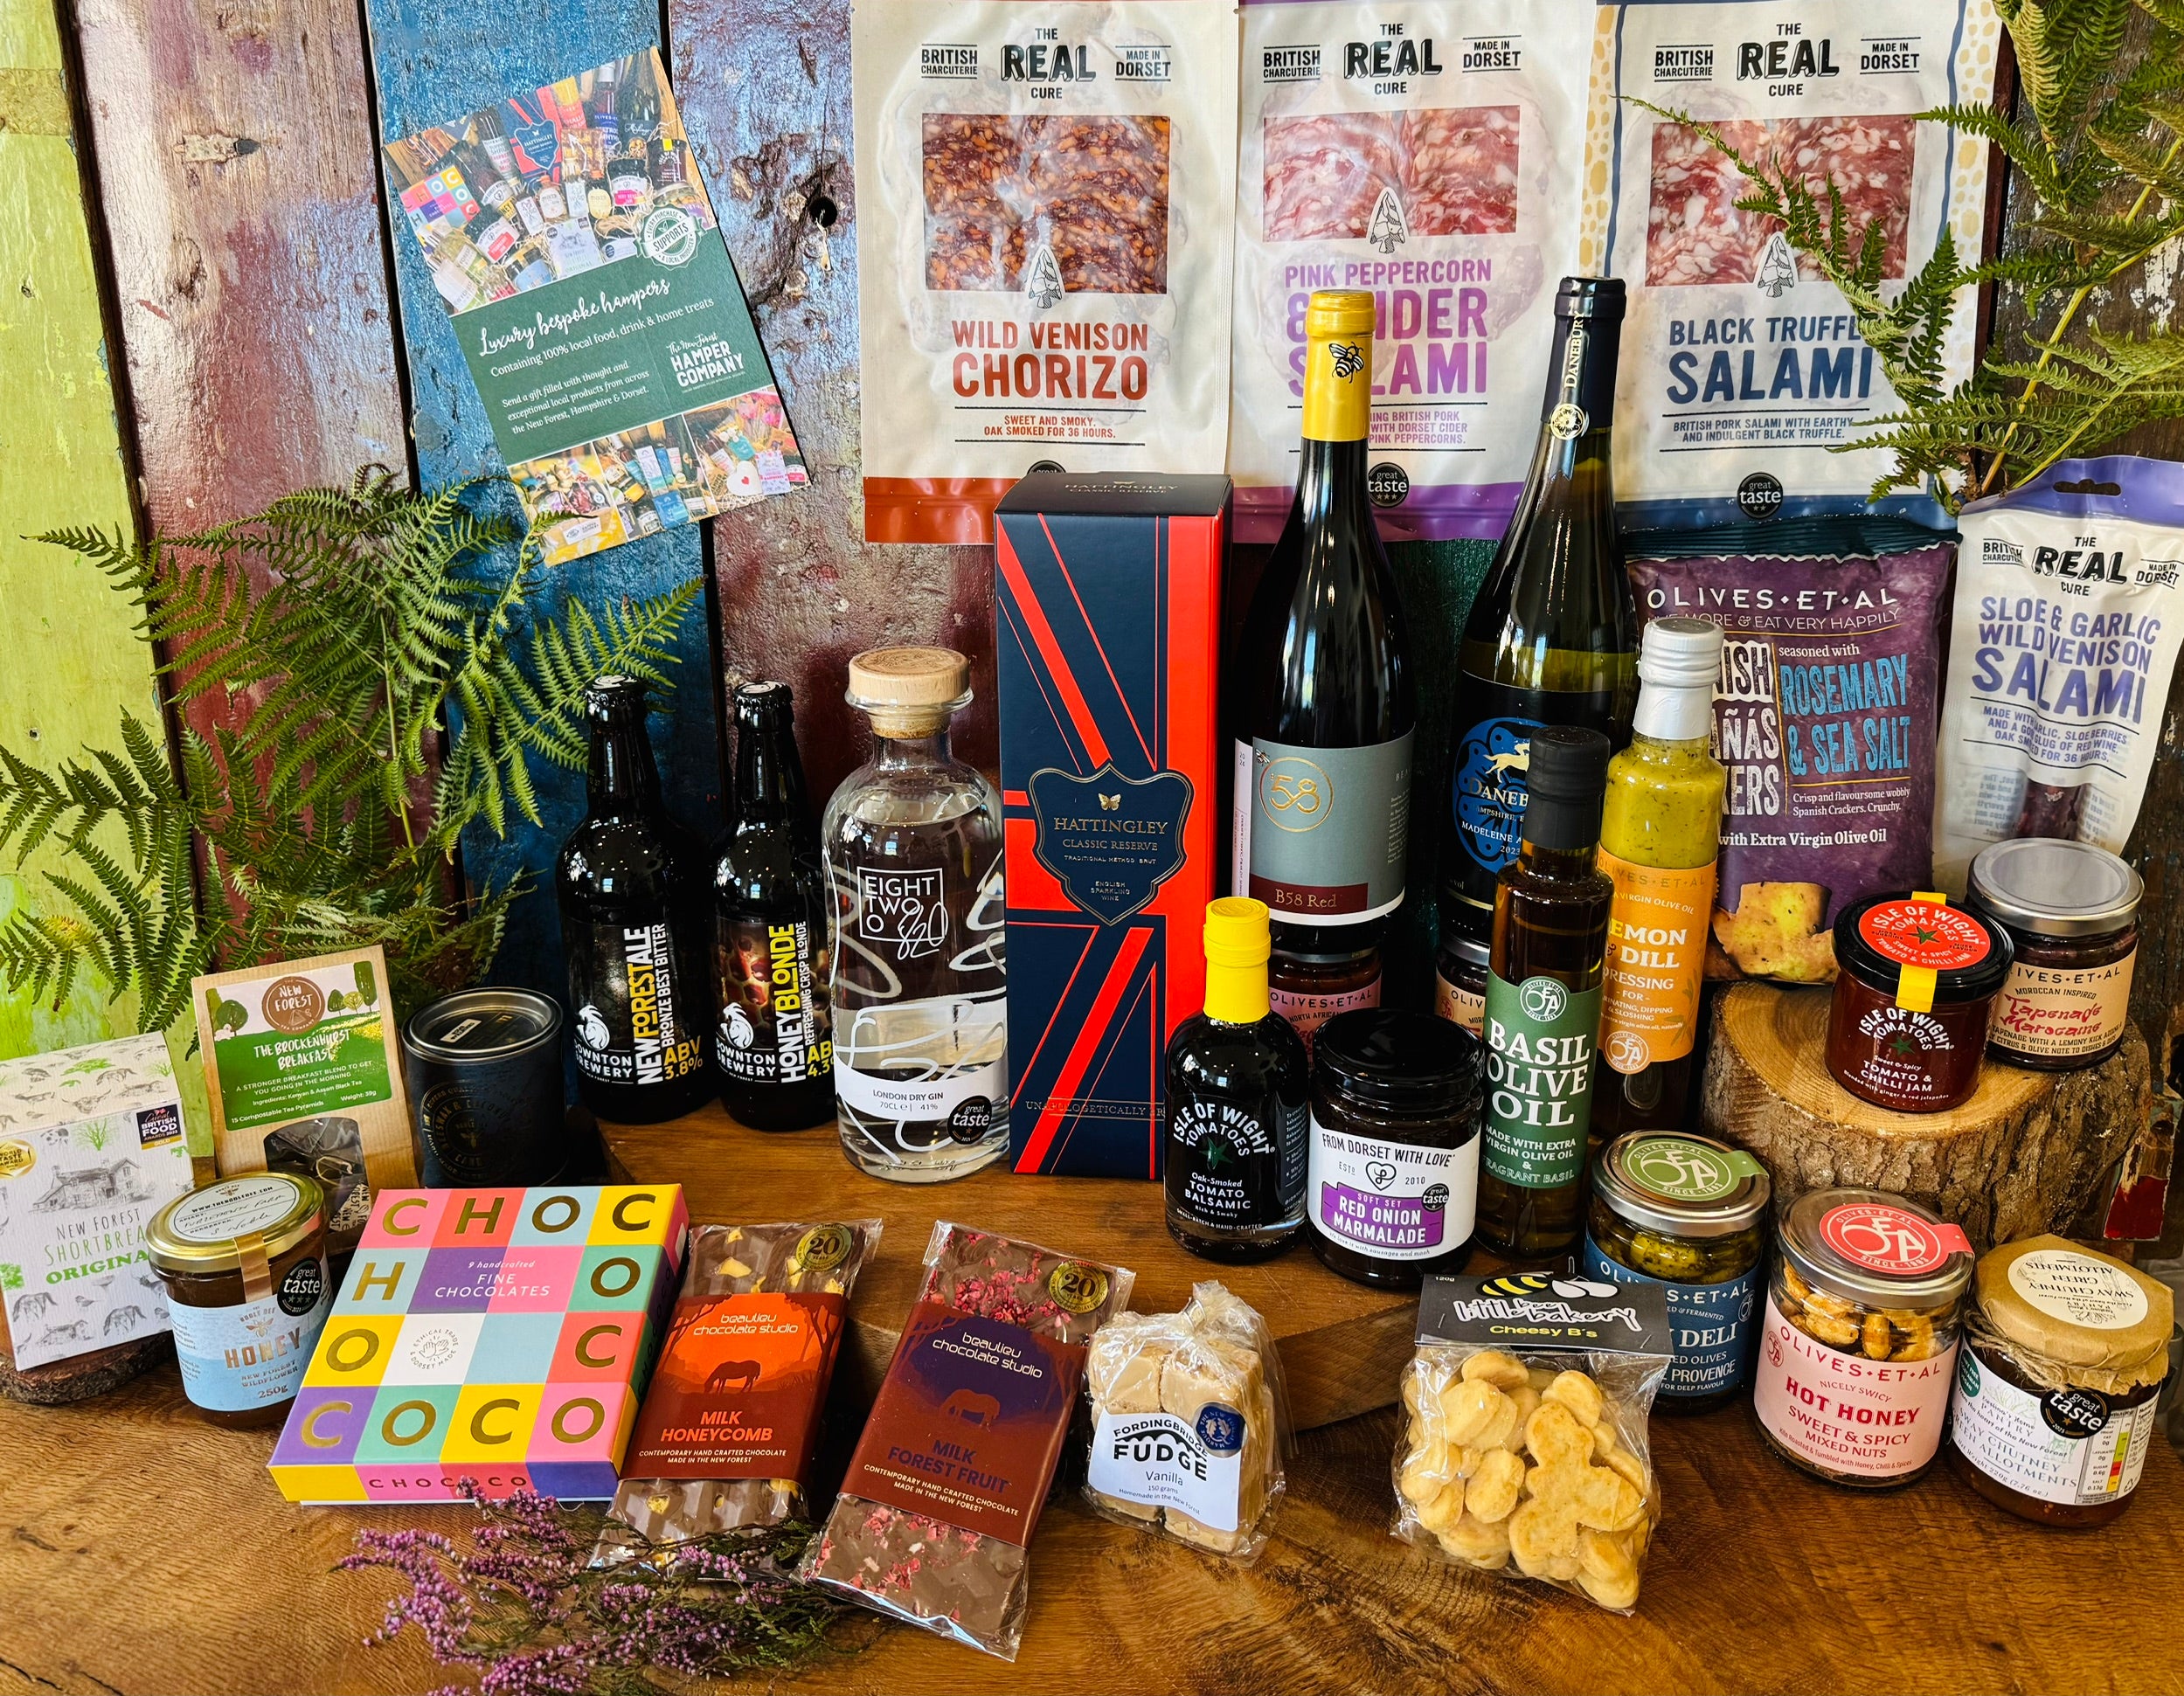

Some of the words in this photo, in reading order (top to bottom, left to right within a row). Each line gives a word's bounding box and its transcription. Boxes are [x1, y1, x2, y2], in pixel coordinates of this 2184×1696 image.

[1035, 28, 1057, 40] THE
[922, 49, 977, 65] BRITISH
[1001, 45, 1096, 82] REAL
[1127, 51, 1148, 60] MADE
[1152, 51, 1160, 60] IN
[921, 65, 977, 75] CHARCUTERIE
[1116, 61, 1171, 77] DORSET
[1030, 87, 1063, 99] CURE
[654, 223, 689, 252] SUPPORTS
[1285, 265, 1336, 287] PINK
[1346, 259, 1492, 286] PEPPERCORN
[479, 328, 536, 357] Luxury
[537, 297, 600, 335] bespoke
[600, 280, 669, 313] hampers
[1669, 318, 1755, 346] BLACK
[1765, 315, 1862, 343] TRUFFL
[491, 353, 542, 377] Containing
[544, 345, 569, 360] 100%
[569, 339, 593, 352] local
[593, 329, 621, 343] food,
[621, 320, 645, 335] drink
[647, 316, 655, 326] &
[656, 308, 683, 324] home
[685, 298, 714, 313] treats
[952, 321, 1018, 349] WILD
[1030, 322, 1147, 350] VENISON
[669, 341, 731, 372] HAMPER
[1565, 311, 1584, 388] DANEBURY
[676, 353, 744, 387] COMPANY
[953, 353, 1147, 400] CHORIZO
[1667, 347, 1873, 405] SALAMI
[984, 426, 1002, 435] OAK
[1006, 426, 1044, 436] SMOKED
[1048, 427, 1064, 436] FOR
[1068, 427, 1079, 436] 36
[1082, 428, 1115, 438] HOURS.
[1674, 421, 1711, 432] BRITISH
[1715, 419, 1741, 429] PORK
[1745, 419, 1781, 428] SALAMI
[1785, 418, 1810, 427] WITH
[1813, 417, 1853, 427] EARTHY
[1682, 433, 1702, 442] AND
[1706, 431, 1760, 441] INDULGENT
[1764, 430, 1794, 440] BLACK
[1799, 429, 1845, 439] TRUFFLE.
[1980, 596, 2047, 622] SLOE
[2051, 605, 2062, 631] &
[2070, 613, 2160, 645] GARLIC
[1778, 645, 1830, 657] seasoned
[1832, 644, 1860, 656] with
[1778, 654, 1908, 716] ROSEMARY
[1972, 647, 2146, 724] SALAMI
[1788, 724, 1807, 777] &
[1811, 721, 1859, 775] SEA
[1862, 716, 1911, 772] SALT
[1792, 805, 1827, 817] Spanish
[1828, 803, 1866, 815] Crackers.
[1868, 802, 1902, 813] Crunchy.
[1054, 818, 1168, 834] HATTINGLEY
[1718, 834, 1747, 846] with
[1751, 833, 1786, 846] Extra
[1788, 832, 1833, 848] Virgin
[1834, 831, 1868, 844] Olive
[1869, 828, 1886, 842] Oil
[1063, 839, 1106, 848] CLASSIC
[1111, 841, 1158, 851] RESERVE
[866, 876, 934, 898] EIGHT
[1275, 890, 1303, 906] B58
[1307, 895, 1337, 908] Red
[867, 896, 921, 914] TWO
[652, 924, 669, 966] BITTER
[1620, 945, 1680, 968] DILL
[280, 986, 302, 998] NEW
[655, 966, 671, 997] BEST
[2063, 989, 2097, 1000] INSPIRED
[274, 994, 313, 1012] FOREST
[2004, 993, 2102, 1022] Tapenade
[658, 998, 675, 1047] BRONZE
[1859, 1008, 1886, 1036] ISLE
[1887, 1007, 1907, 1021] OF
[1911, 1013, 1951, 1050] WIGHT
[253, 1045, 273, 1058] THE
[274, 1028, 350, 1055] BROCKENHURST
[1488, 1017, 1590, 1066] BASIL
[278, 1048, 331, 1070] BREAKFAST
[1863, 1061, 1918, 1081] TOMATO
[1487, 1052, 1588, 1097] OLIVE
[1861, 1070, 1902, 1089] CHILLI
[1906, 1083, 1932, 1092] JAM
[873, 1090, 908, 1102] LONDON
[909, 1091, 926, 1101] DRY
[928, 1091, 944, 1101] GIN
[1492, 1090, 1575, 1127] OIL
[1322, 1133, 1345, 1152] FROM
[1349, 1140, 1390, 1160] DORSET
[1394, 1149, 1422, 1164] WITH
[1425, 1153, 1452, 1167] LOVE
[1486, 1124, 1510, 1144] MADE
[1513, 1139, 1543, 1150] WITH
[1546, 1138, 1576, 1151] EXTRA
[1185, 1189, 1251, 1208] BALSAMIC
[1189, 1180, 1244, 1198] TOMATO
[1339, 1195, 1365, 1218] RED
[1372, 1208, 1421, 1225] ONION
[57, 1222, 92, 1241] NEW
[94, 1208, 140, 1230] FOREST
[1334, 1211, 1425, 1243] MARMALADE
[44, 1225, 146, 1266] SHORTBREA
[45, 1250, 149, 1285] ORIGINA
[297, 1267, 315, 1279] great
[477, 1273, 516, 1285] FINE
[284, 1277, 320, 1294] taste
[434, 1285, 551, 1298] CHOCOLATES
[693, 1325, 757, 1335] chocolate
[759, 1324, 798, 1333] studio
[720, 1314, 776, 1323] beaulieu
[1490, 1326, 1562, 1337] Cheesy
[225, 1327, 301, 1369] HONEY
[1679, 1322, 1737, 1348] DELI
[258, 1385, 288, 1399] 250g
[1785, 1376, 1830, 1410] HOT
[1838, 1402, 1921, 1426] HONEY
[701, 1410, 742, 1425] MILK
[1788, 1405, 1842, 1438] SWEET
[1845, 1430, 1858, 1443] &
[1863, 1432, 1910, 1446] SPICY
[661, 1428, 773, 1442] HONEYCOMB
[1113, 1419, 1208, 1457] FORDINGBRIDGE
[1805, 1430, 1848, 1453] MIXED
[1852, 1444, 1888, 1458] NUTS
[933, 1439, 977, 1464] MILK
[1113, 1443, 1207, 1481] FUDGE
[888, 1447, 957, 1477] FOREST
[958, 1469, 1009, 1492] FRUIT
[1146, 1471, 1183, 1485] Vanilla
